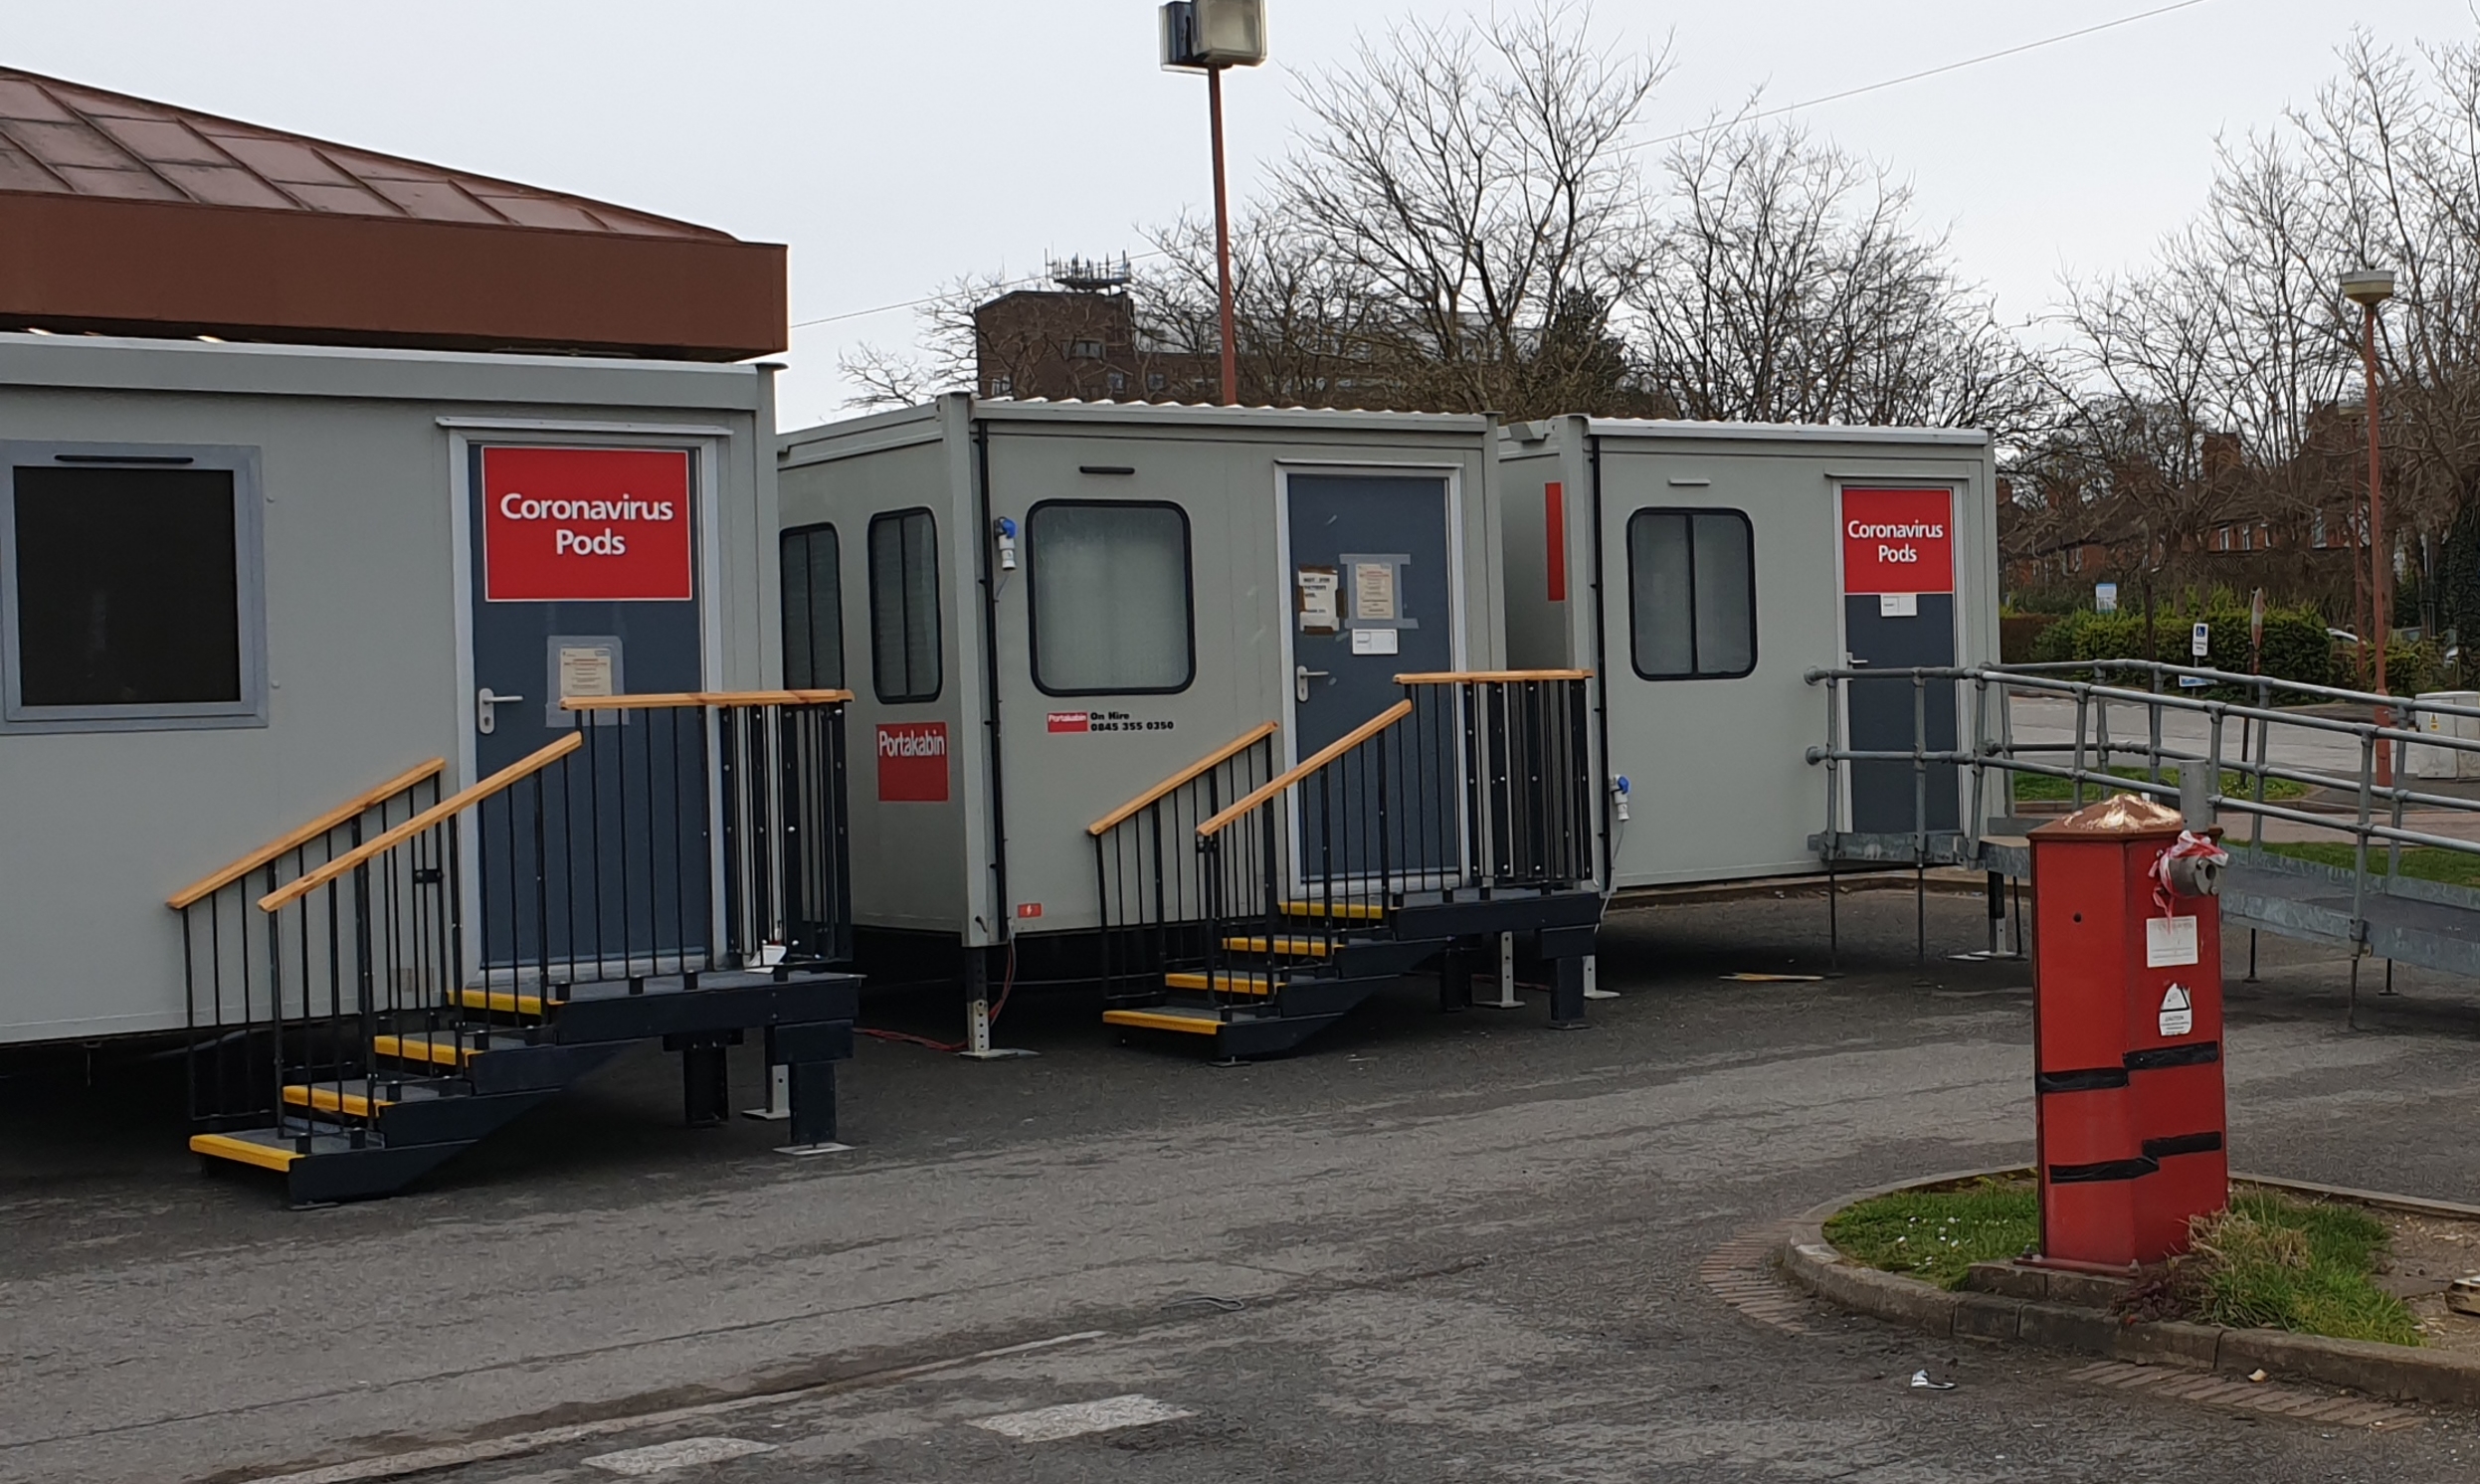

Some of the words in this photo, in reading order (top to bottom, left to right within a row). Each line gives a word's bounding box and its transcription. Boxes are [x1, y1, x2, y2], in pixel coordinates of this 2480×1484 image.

[500, 492, 673, 521] Coronavirus
[1847, 519, 1944, 538] Coronavirus
[556, 528, 626, 555] Pods
[1877, 543, 1918, 563] Pods
[1048, 713, 1087, 722] Portakabin
[1108, 711, 1130, 720] Hire
[1122, 722, 1143, 731] 355
[1146, 721, 1174, 730] 0350
[878, 729, 945, 757] Portakabin
